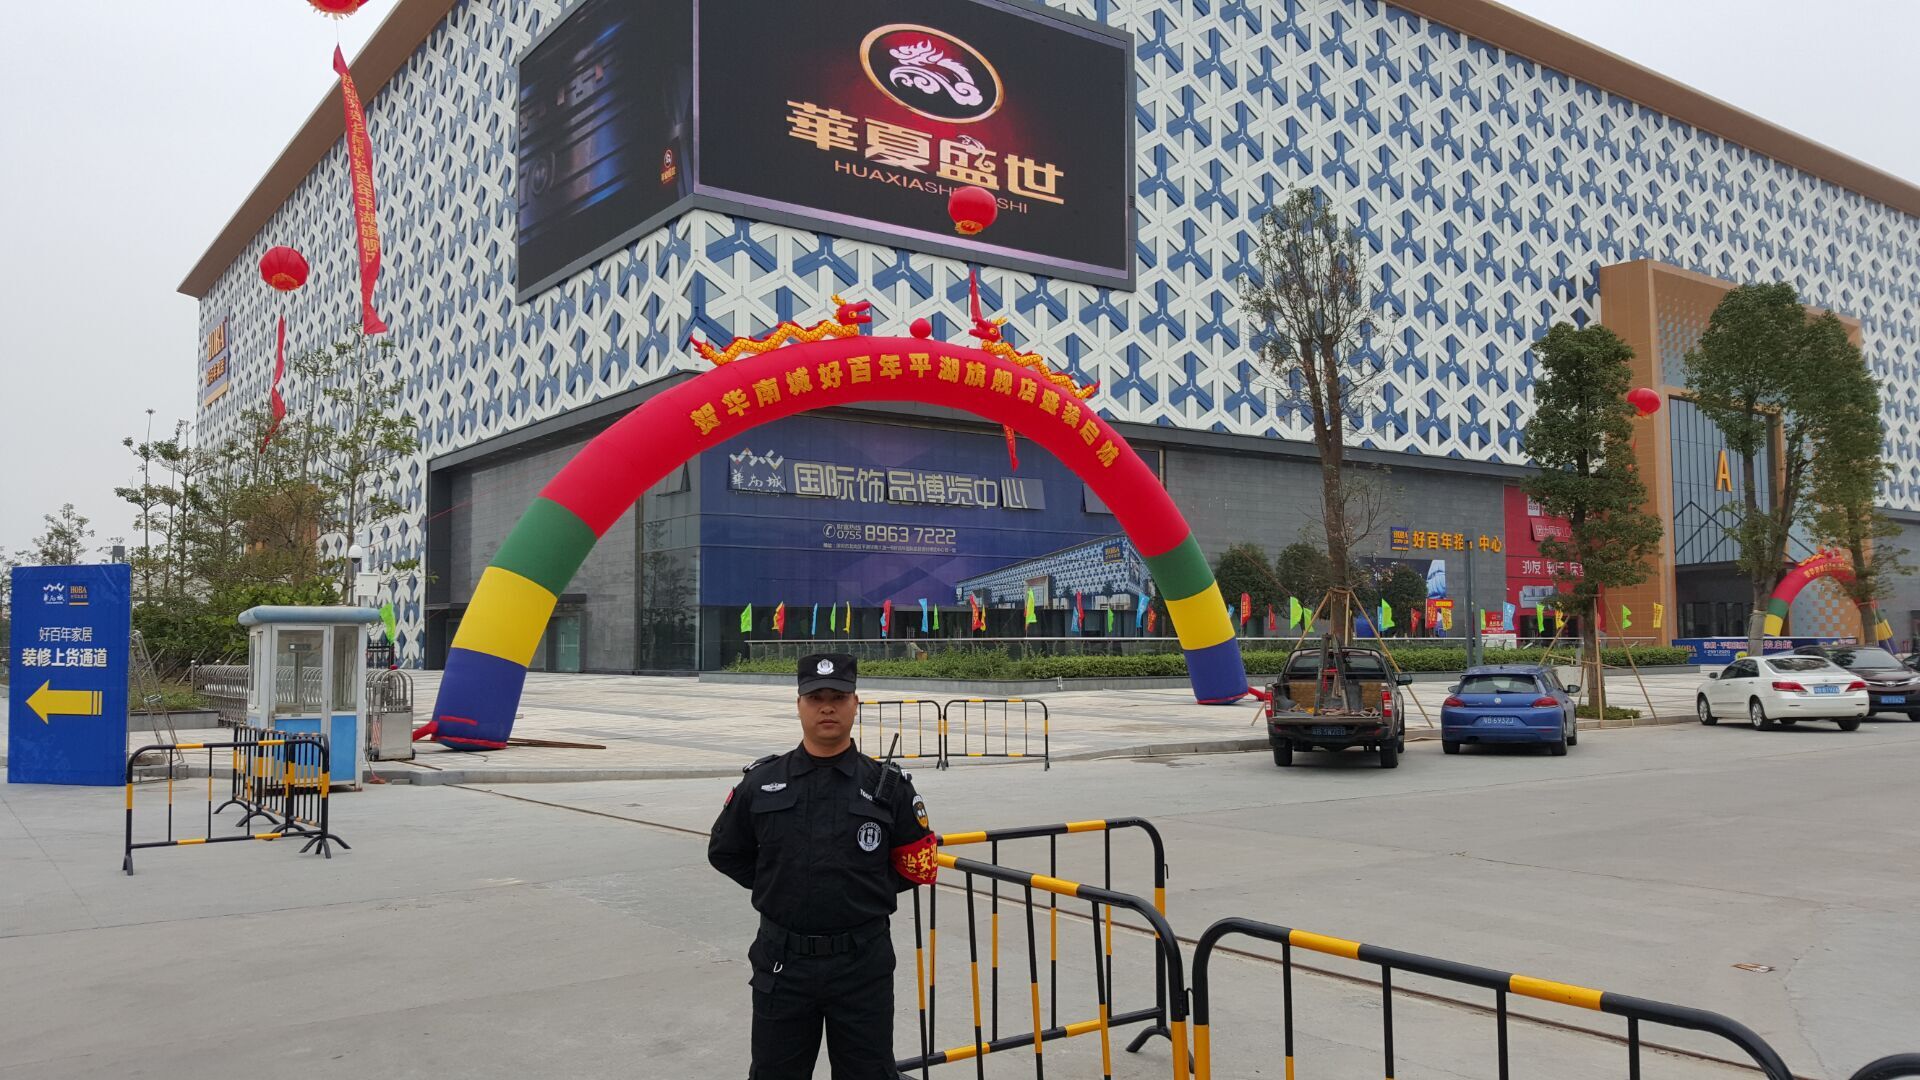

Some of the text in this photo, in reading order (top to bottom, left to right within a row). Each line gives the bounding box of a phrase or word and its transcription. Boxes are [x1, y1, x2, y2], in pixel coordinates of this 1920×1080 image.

[786, 100, 1065, 205] 華夏盛世
[834, 160, 1028, 214] HUAXIASHSHI
[689, 353, 1120, 468] 贺华南城好百年平湖旗舰店盛装启航
[793, 463, 1028, 509] 国际饰品博览中心
[1715, 448, 1732, 492] A
[836, 525, 957, 545] 0755 8963 7222
[1412, 530, 1502, 553] 好百年招中心
[70, 586, 88, 594] HOBA
[39, 627, 93, 642] 好百年家居
[22, 648, 107, 668] 装修上货通道
